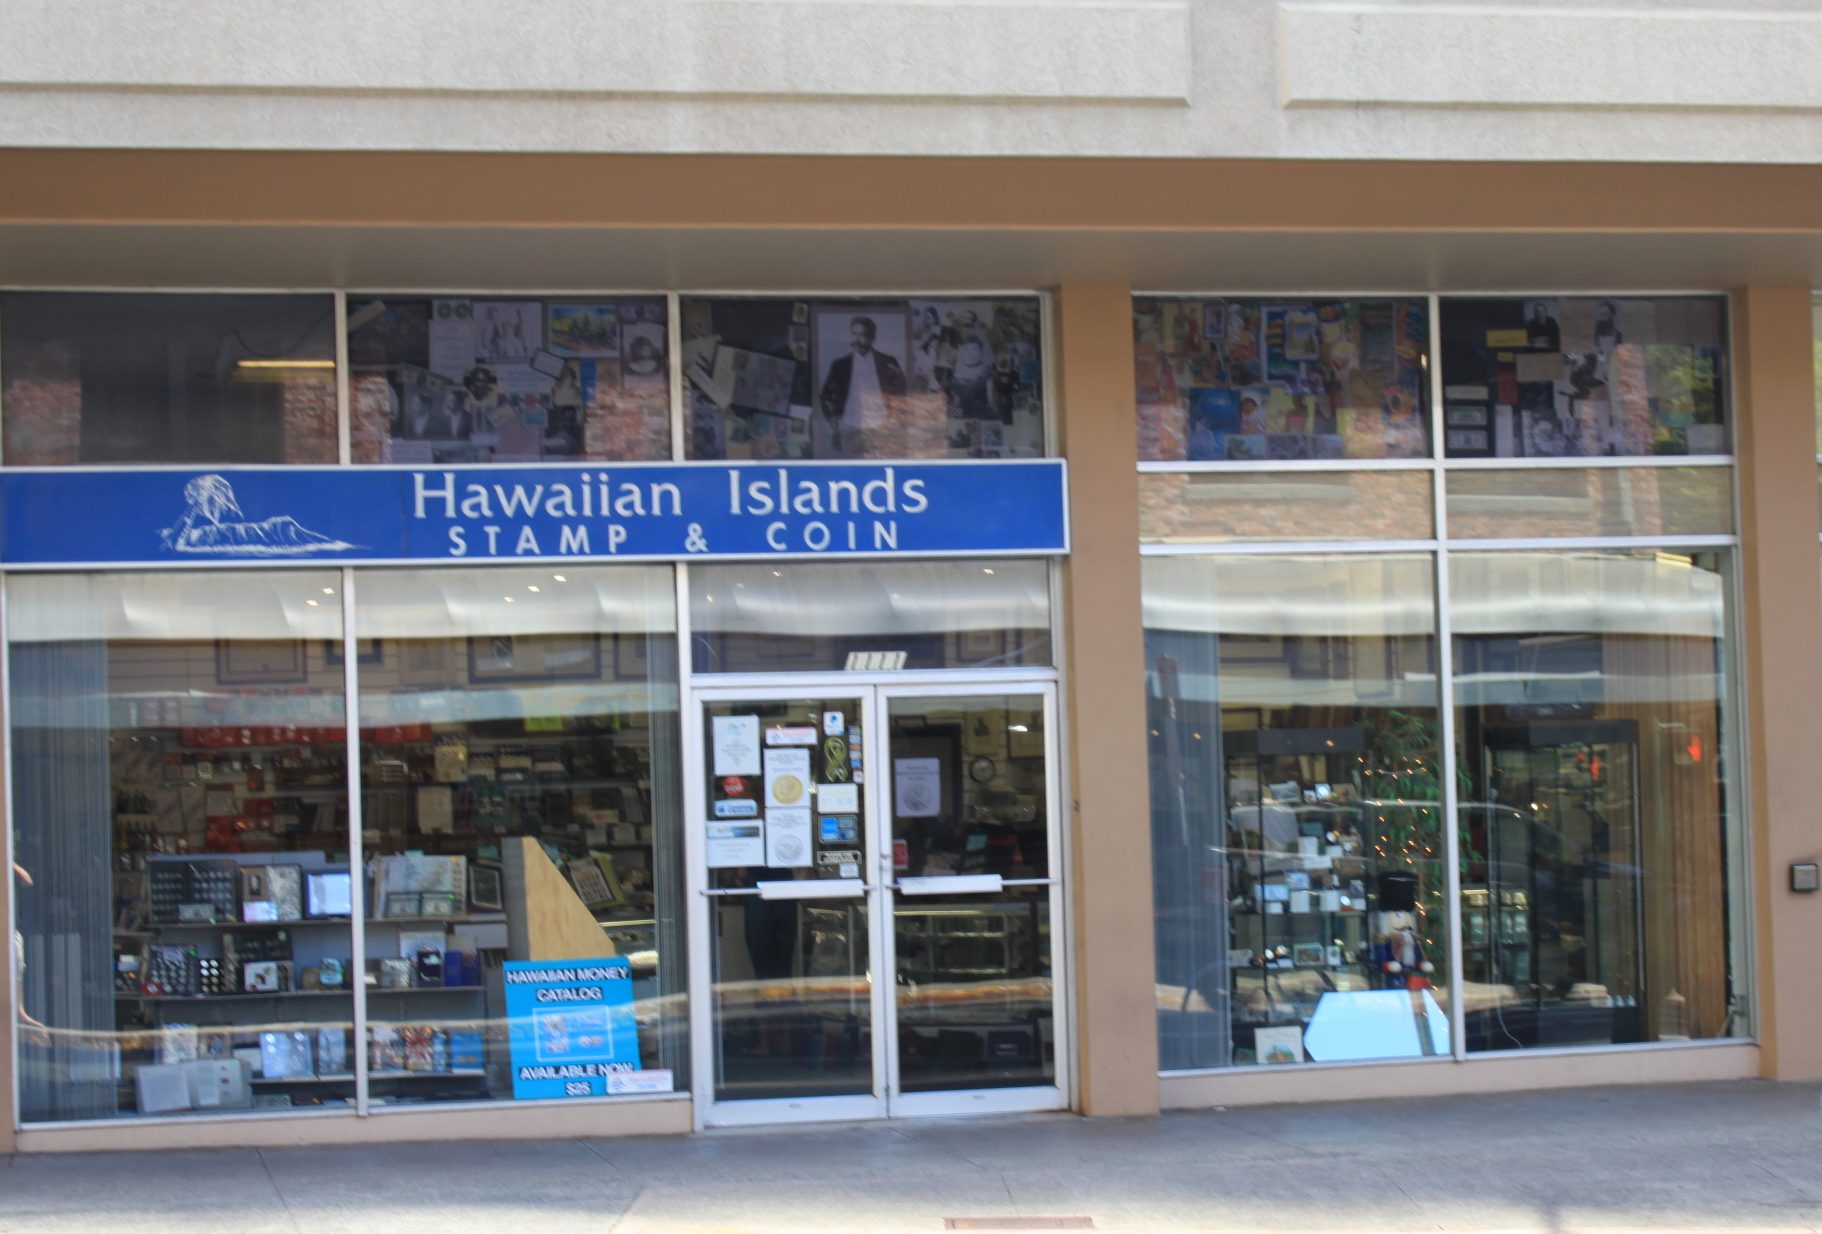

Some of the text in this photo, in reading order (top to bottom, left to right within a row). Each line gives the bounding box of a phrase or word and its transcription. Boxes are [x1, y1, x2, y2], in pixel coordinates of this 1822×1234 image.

[413, 466, 929, 519] Hawaiian Islands
[449, 520, 899, 557] STAMP & COIN
[506, 966, 629, 984] HAWAIIAN MONEY
[536, 987, 603, 1002] CATALOG
[519, 1062, 634, 1080] AVAILABLE NOW
